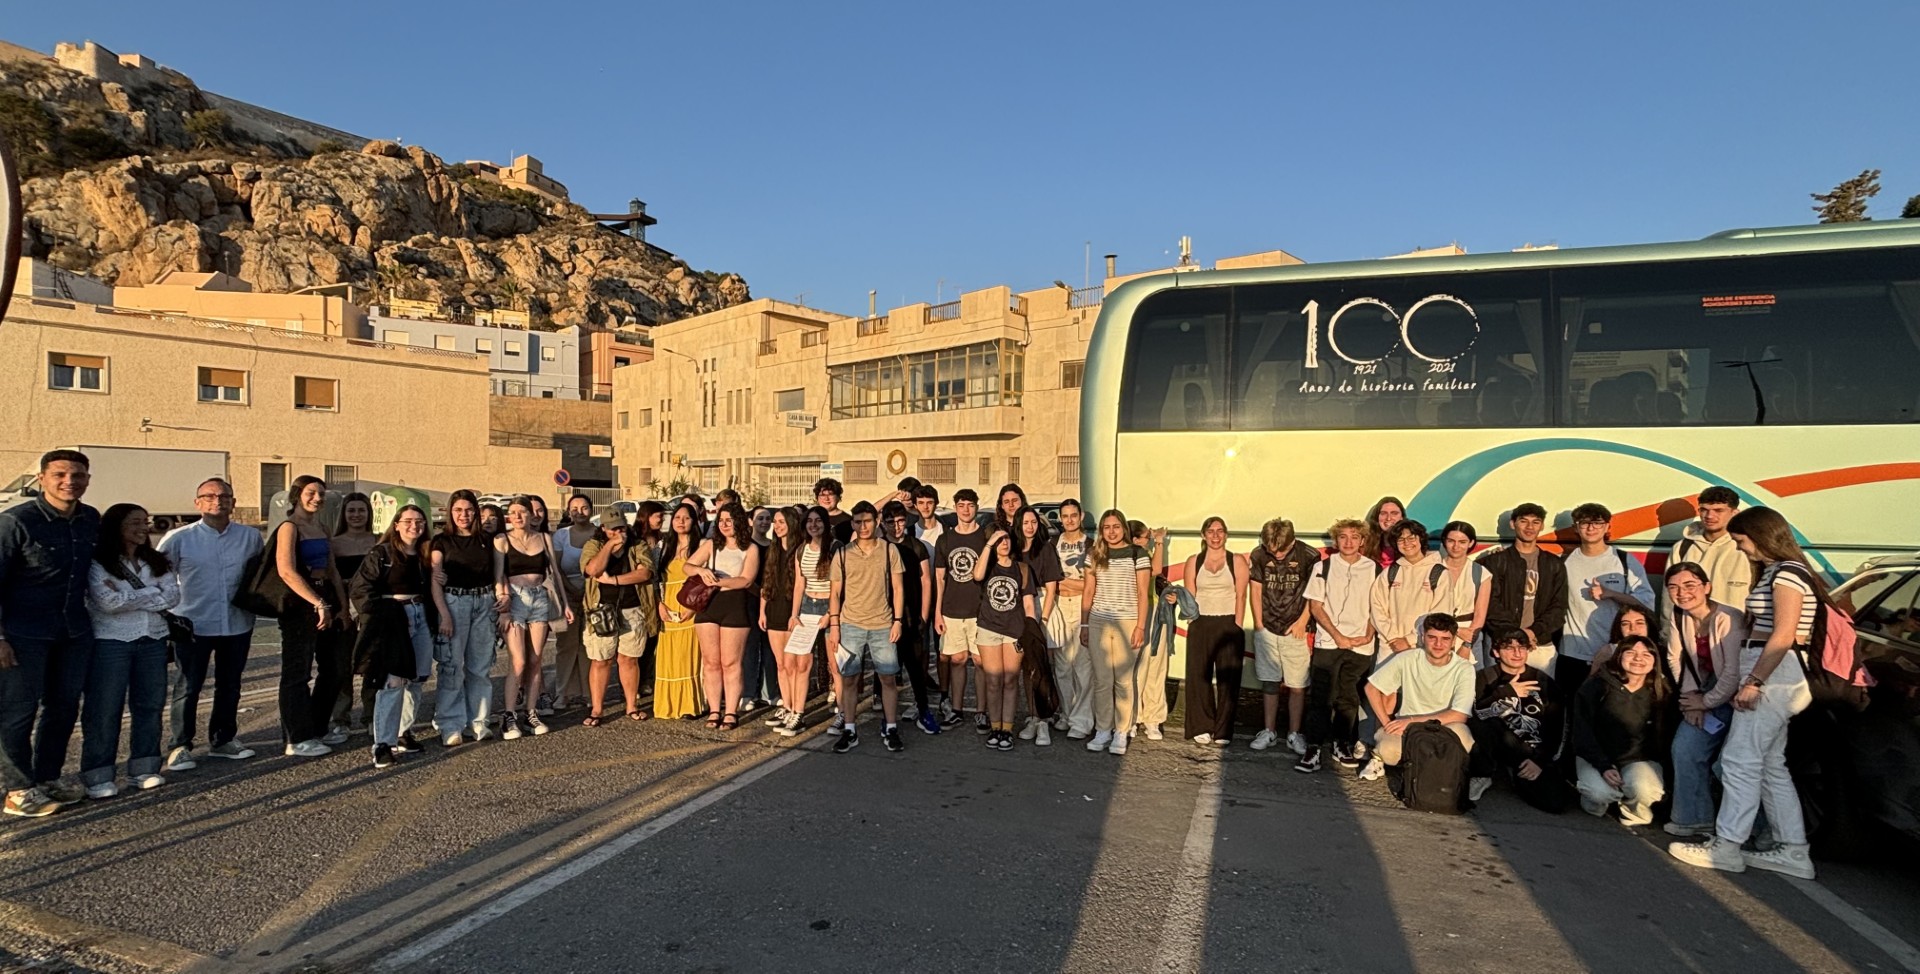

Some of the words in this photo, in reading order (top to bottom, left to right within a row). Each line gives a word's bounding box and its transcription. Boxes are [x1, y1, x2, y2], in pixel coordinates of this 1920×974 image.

[1301, 294, 1480, 368] 100
[1353, 364, 1377, 375] 1921
[1428, 362, 1456, 373] 2021
[1361, 379, 1414, 392] historia
[1423, 378, 1477, 391] familiar
